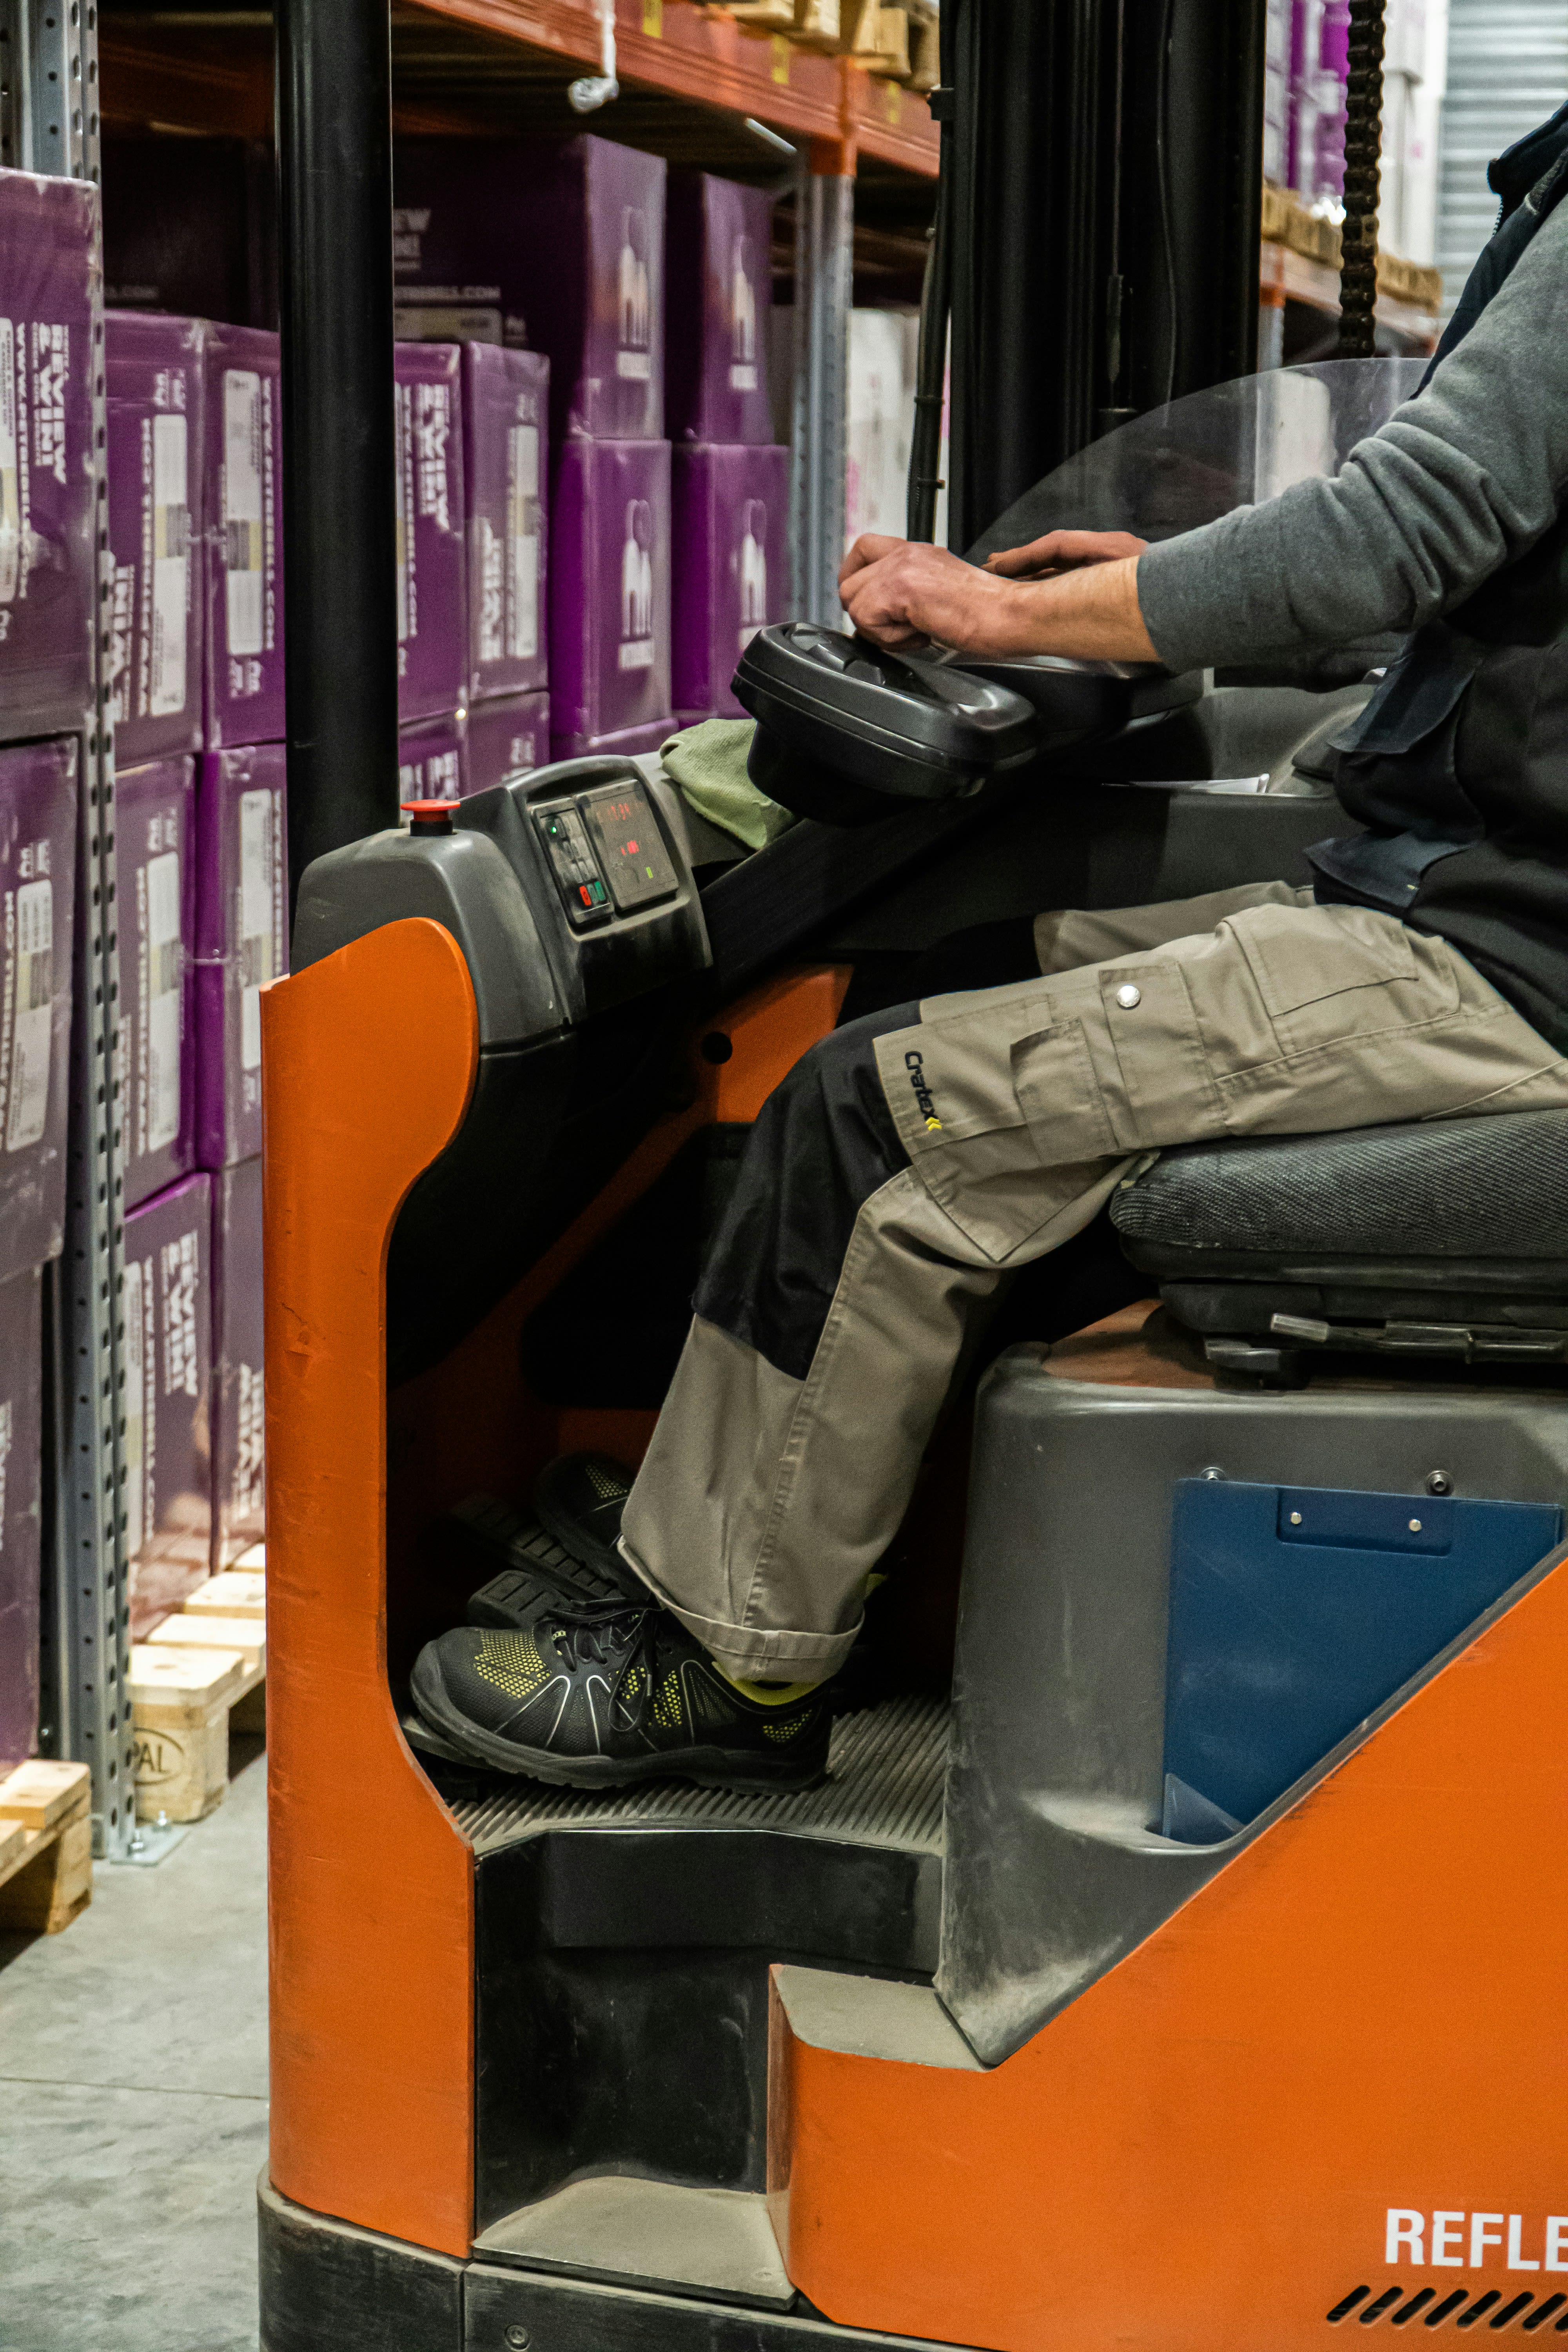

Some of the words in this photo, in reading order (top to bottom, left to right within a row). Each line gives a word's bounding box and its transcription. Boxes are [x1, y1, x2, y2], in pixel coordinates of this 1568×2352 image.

[51, 324, 67, 485] REVIEW
[905, 1051, 940, 1122] Cratex
[180, 1233, 198, 1397] REVIEW
[1385, 2209, 1568, 2272] REFLE
